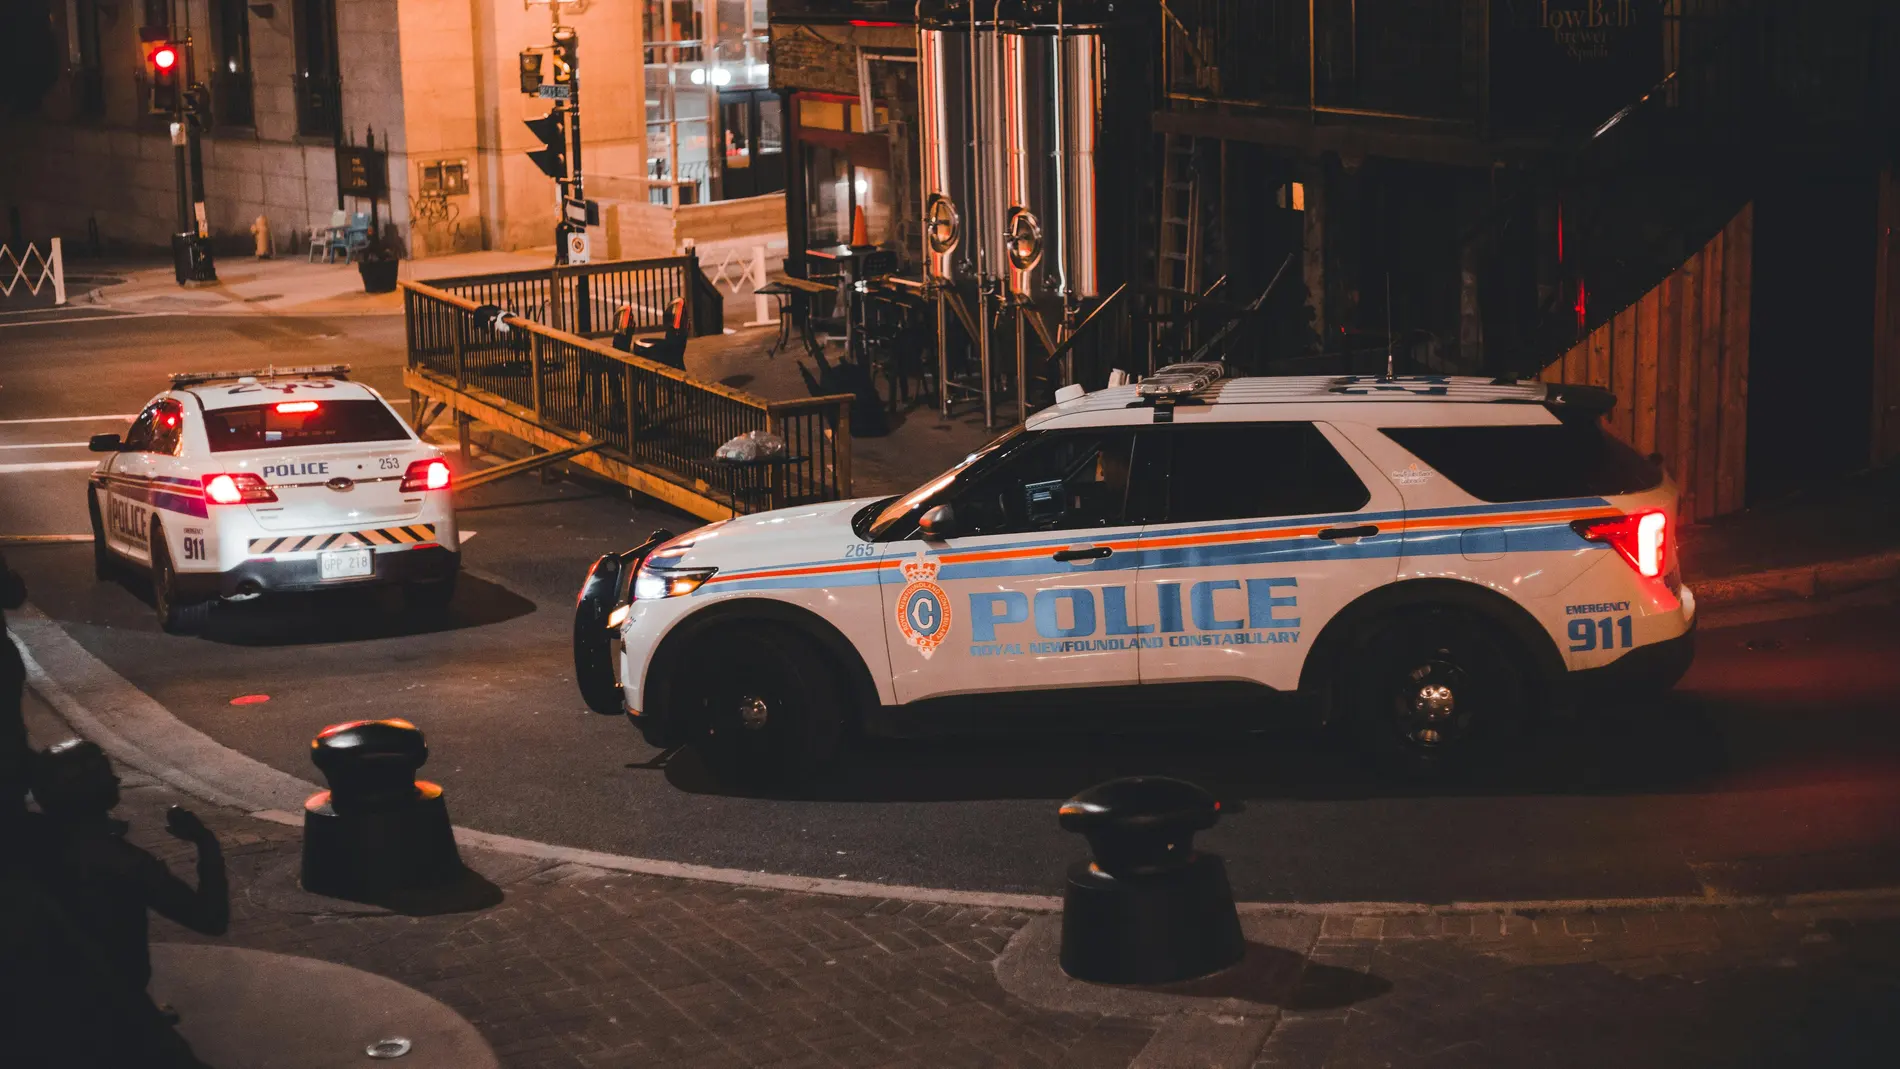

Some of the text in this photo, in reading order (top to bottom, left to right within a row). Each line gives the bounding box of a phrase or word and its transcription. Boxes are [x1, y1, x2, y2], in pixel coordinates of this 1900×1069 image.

[263, 462, 329, 478] POLICE
[379, 458, 400, 470] 253
[112, 497, 148, 543] POLICE
[184, 537, 206, 560] 911
[845, 543, 875, 557] 265
[349, 556, 368, 569] 218
[912, 598, 934, 629] C
[968, 577, 1301, 642] POLICE
[1566, 601, 1631, 615] EMERGENCY
[970, 631, 1300, 657] ROYAL NEWFOUNDLAND CONSTABULARY
[1568, 615, 1632, 652] 911
